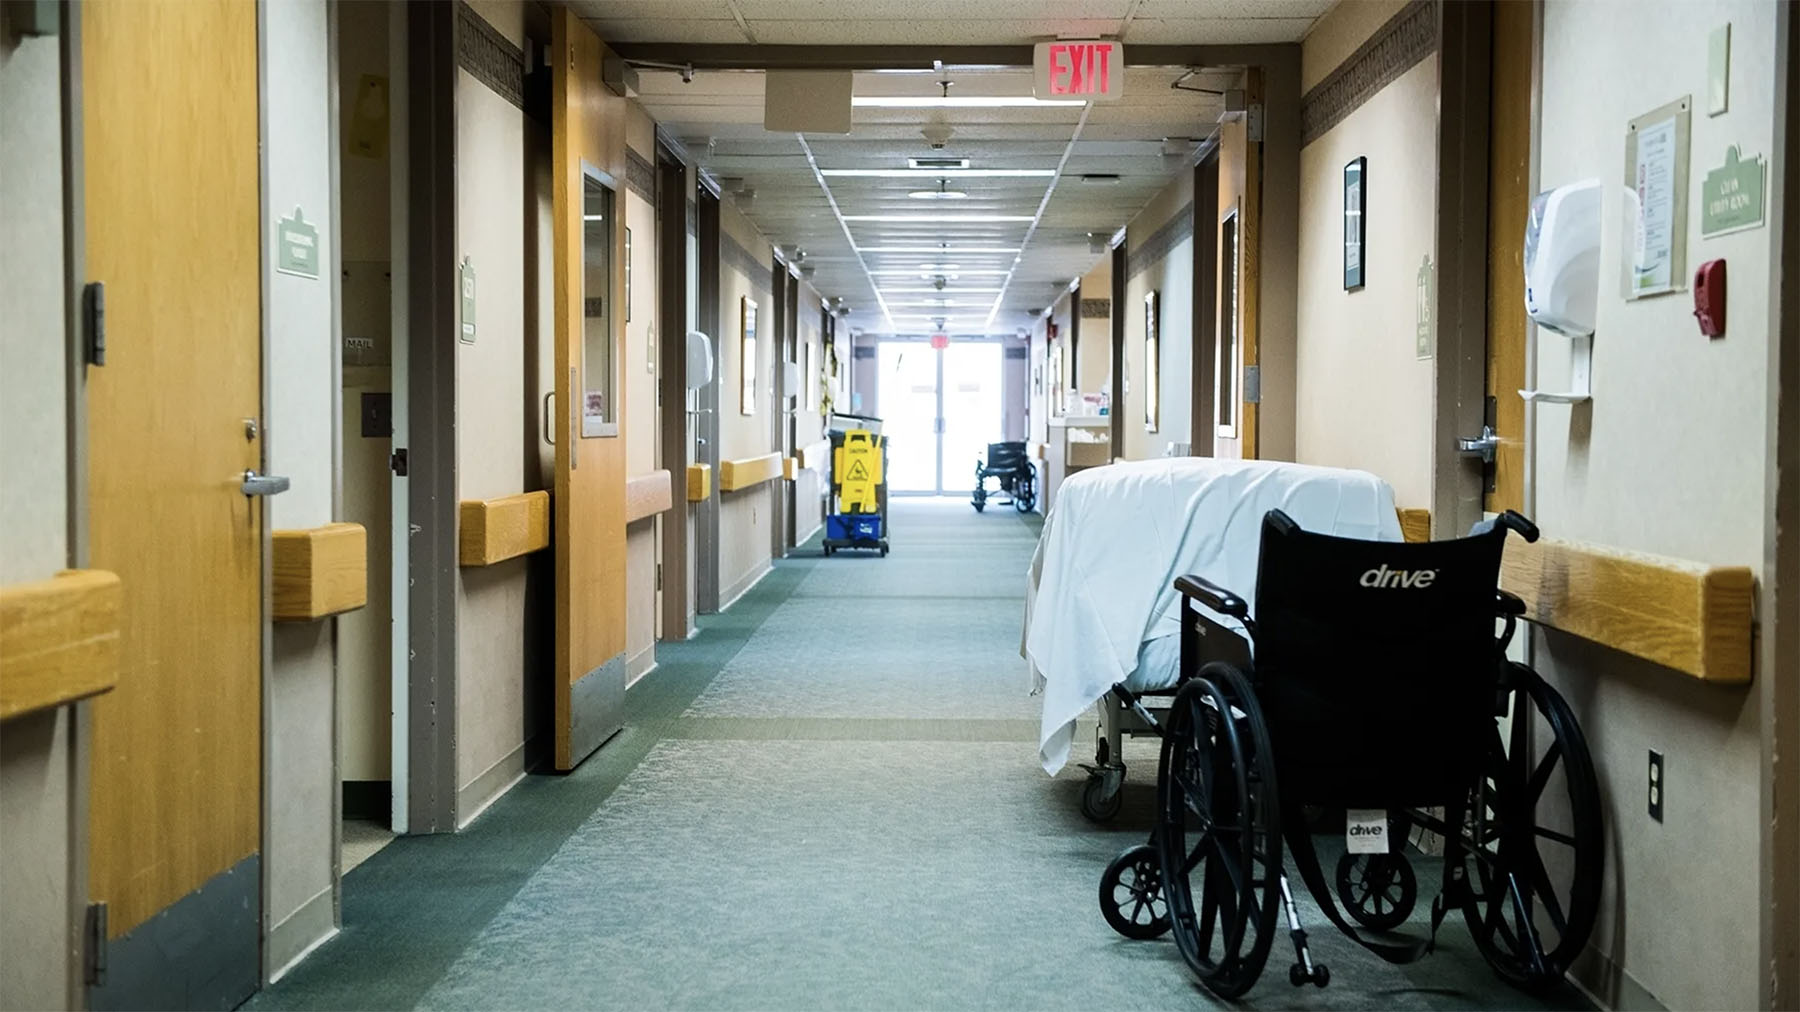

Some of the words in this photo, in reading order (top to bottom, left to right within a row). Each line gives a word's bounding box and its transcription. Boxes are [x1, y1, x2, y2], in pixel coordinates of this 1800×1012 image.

[1049, 44, 1113, 95] EXIT
[347, 339, 372, 349] MAIL
[1359, 563, 1437, 589] drive
[1349, 823, 1383, 837] drive
